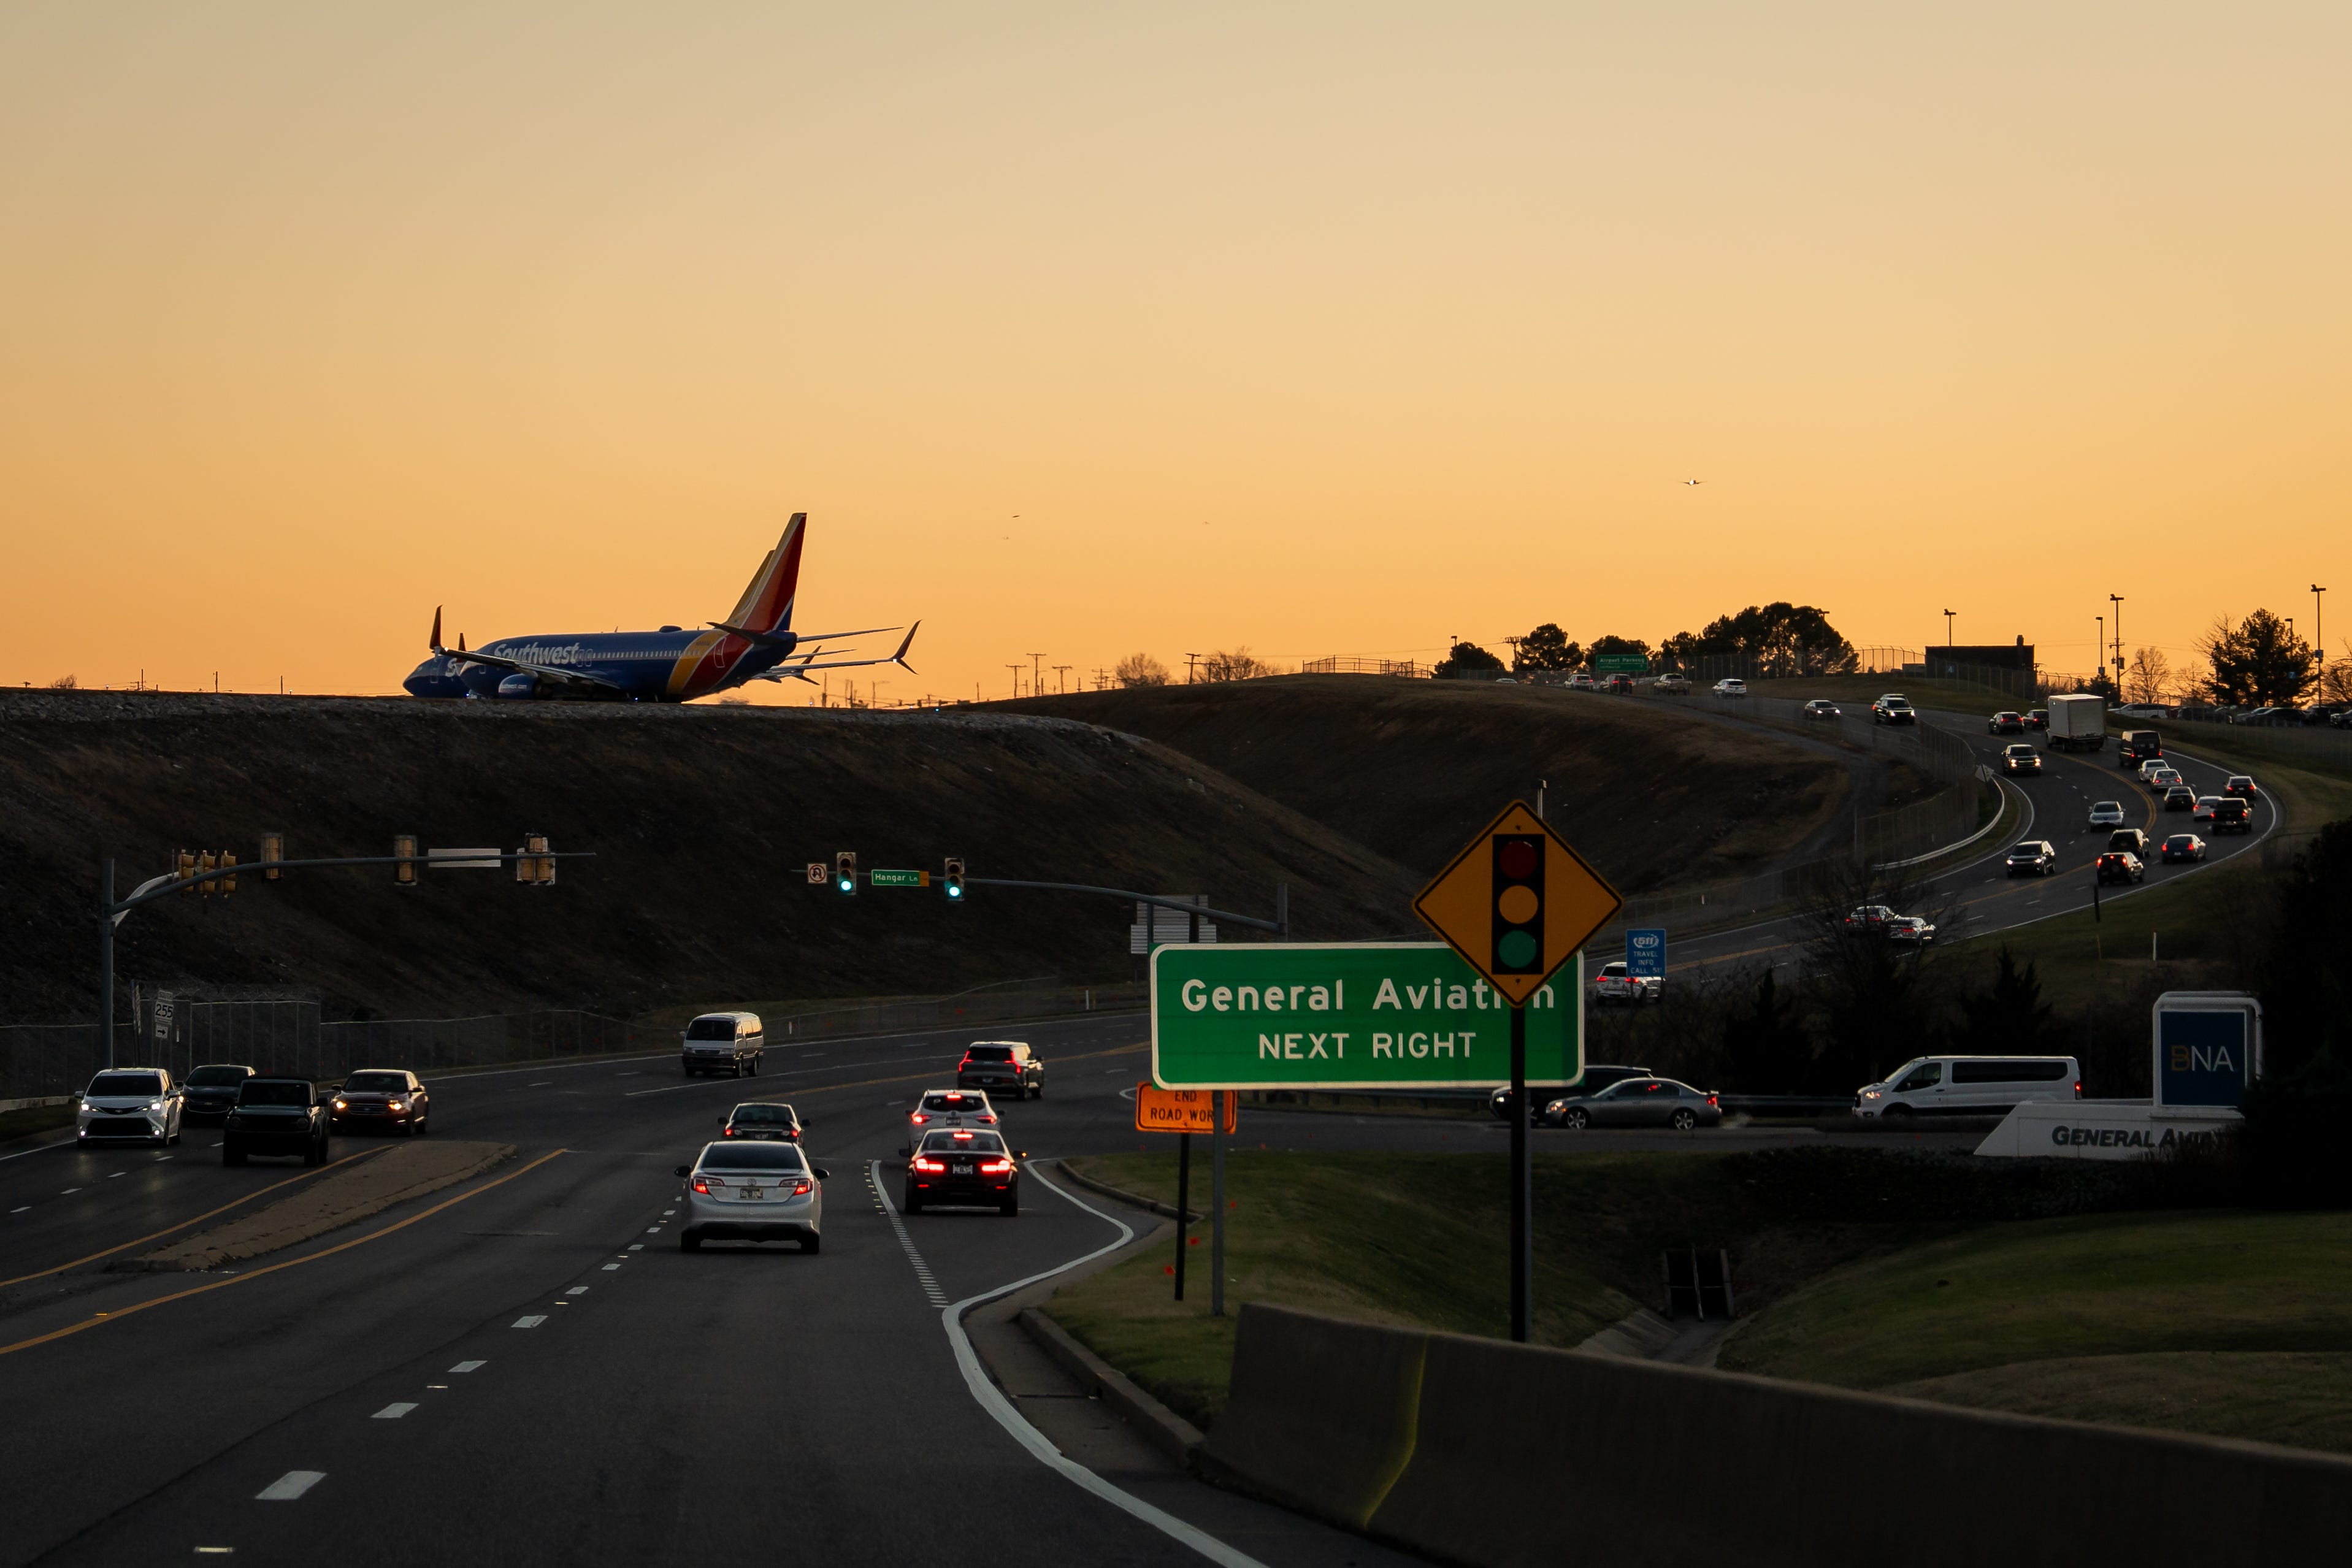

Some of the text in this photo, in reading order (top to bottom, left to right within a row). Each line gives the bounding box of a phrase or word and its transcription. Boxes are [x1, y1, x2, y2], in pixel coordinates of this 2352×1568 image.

[494, 642, 580, 664] Southwest
[875, 873, 906, 882] Hangar
[1182, 977, 1555, 1011] General Aviatin
[155, 1004, 173, 1018] 255
[1259, 1032, 1476, 1060] NEXT RIGHT
[2170, 1044, 2235, 1073] BNA
[1174, 1091, 1197, 1102] END
[1151, 1108, 1182, 1121] ROAD
[2052, 1125, 2155, 1147] GENERAL
